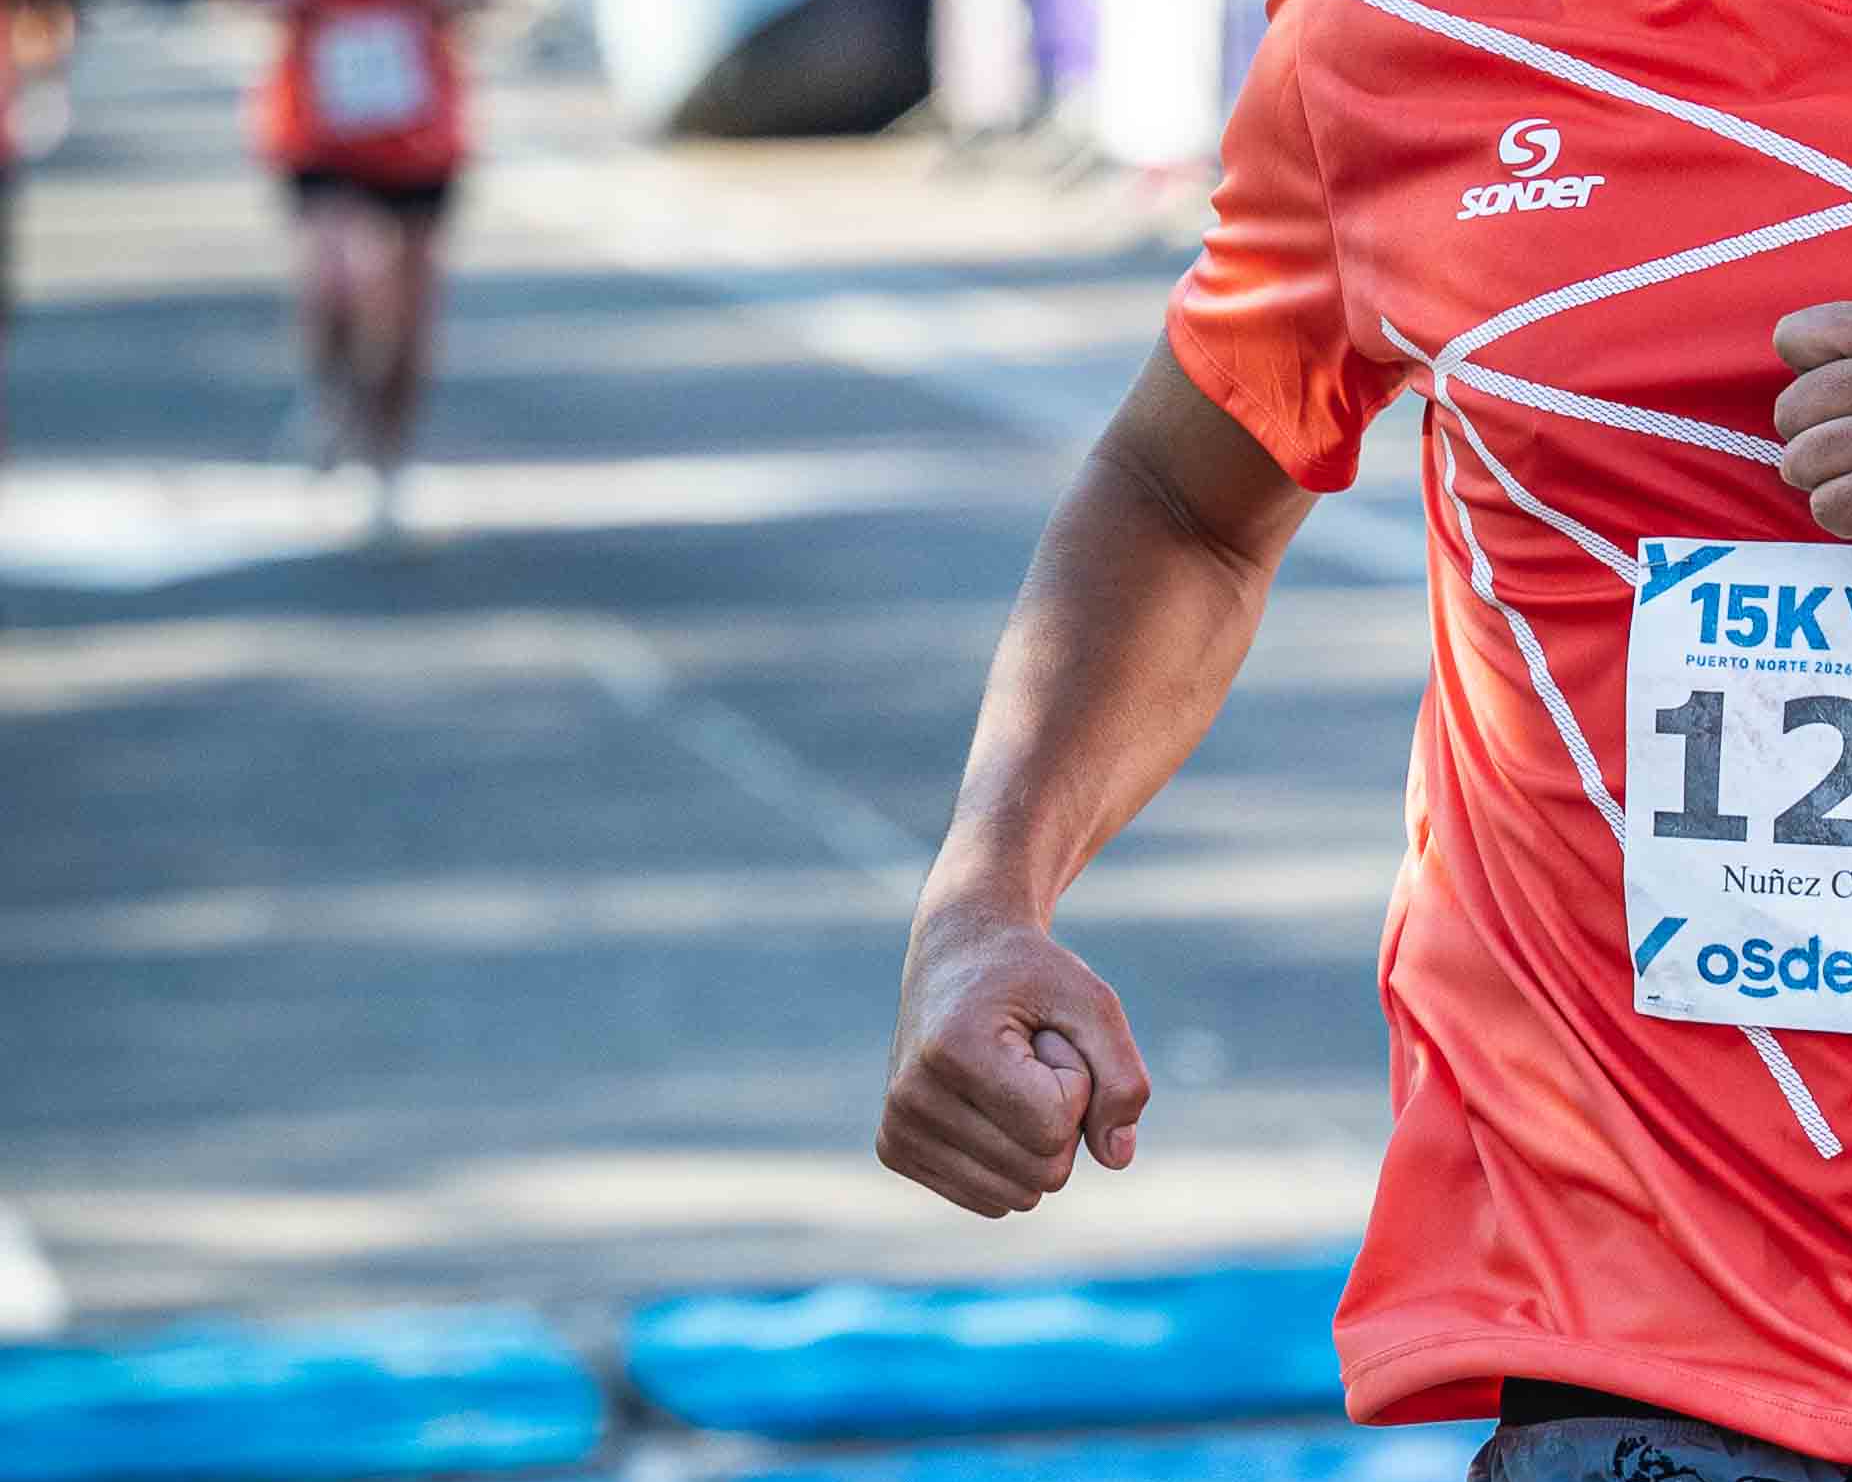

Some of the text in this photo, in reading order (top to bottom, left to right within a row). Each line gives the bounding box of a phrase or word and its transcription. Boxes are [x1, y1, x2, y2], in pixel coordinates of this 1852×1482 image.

[1691, 582, 1832, 650] 15K
[1686, 653, 1749, 670] PUERTO
[1756, 658, 1807, 672] NORTE
[1722, 864, 1821, 897] Nuñez
